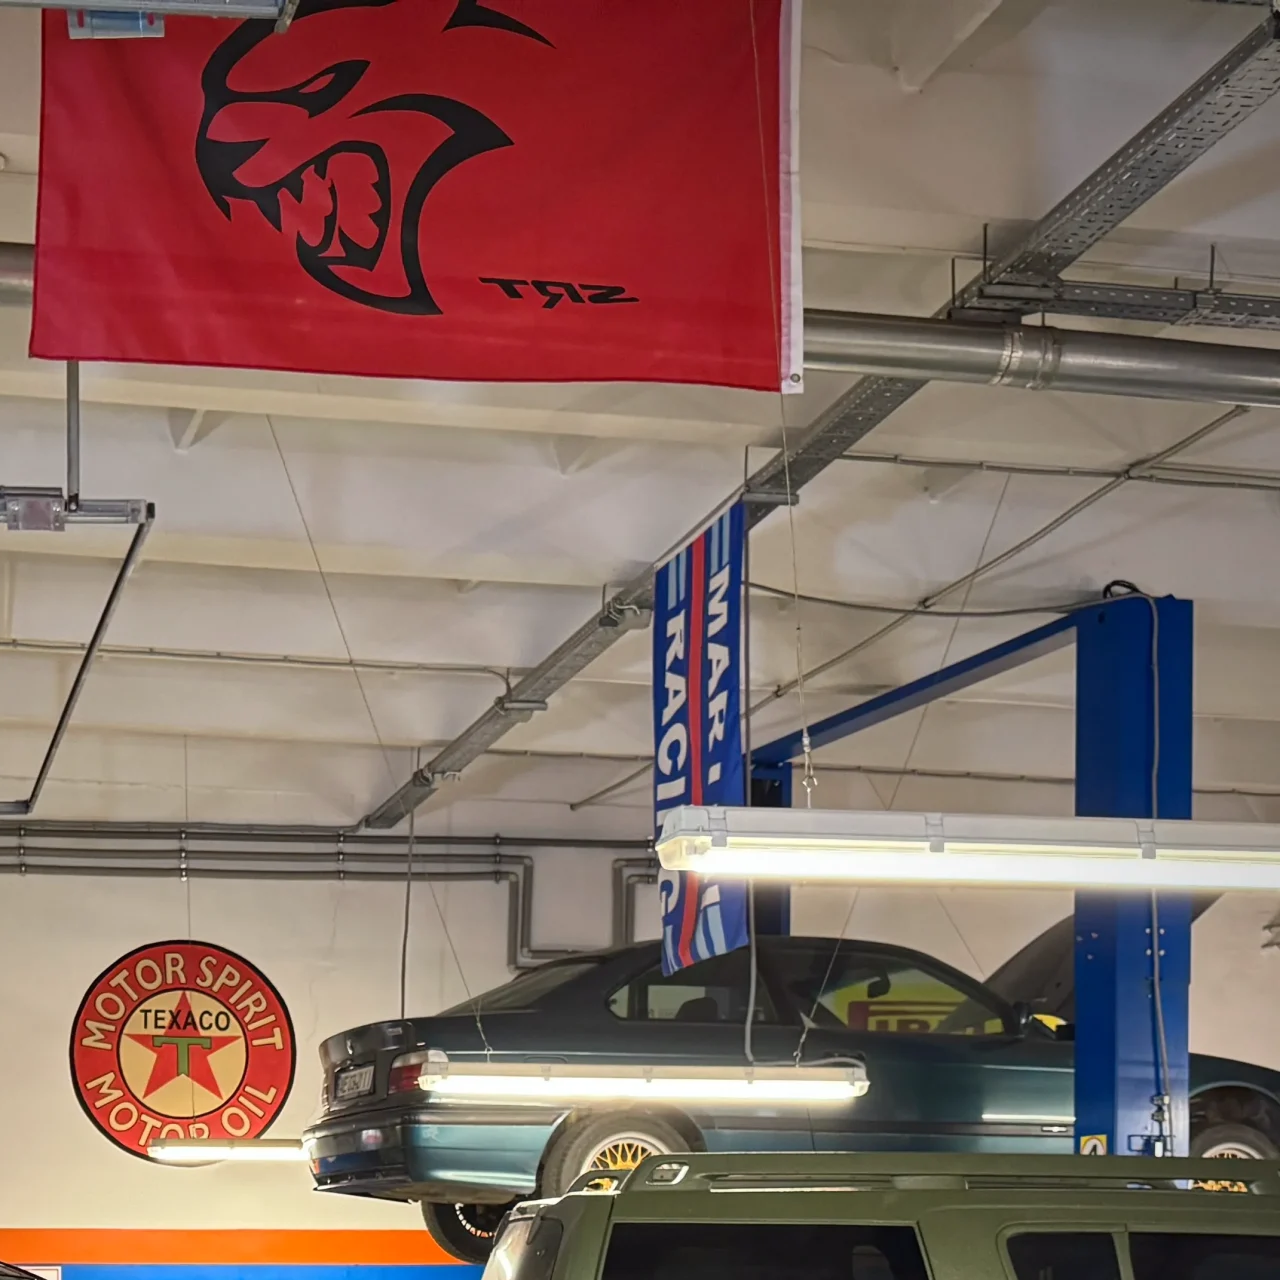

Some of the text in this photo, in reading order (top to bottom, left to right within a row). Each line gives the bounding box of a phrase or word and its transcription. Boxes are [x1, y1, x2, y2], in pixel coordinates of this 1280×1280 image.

[657, 609, 687, 918] RACIG
[81, 953, 284, 1051] MOTOR SPIRIT
[140, 1009, 230, 1032] TEXACO
[221, 1085, 277, 1137] OIL
